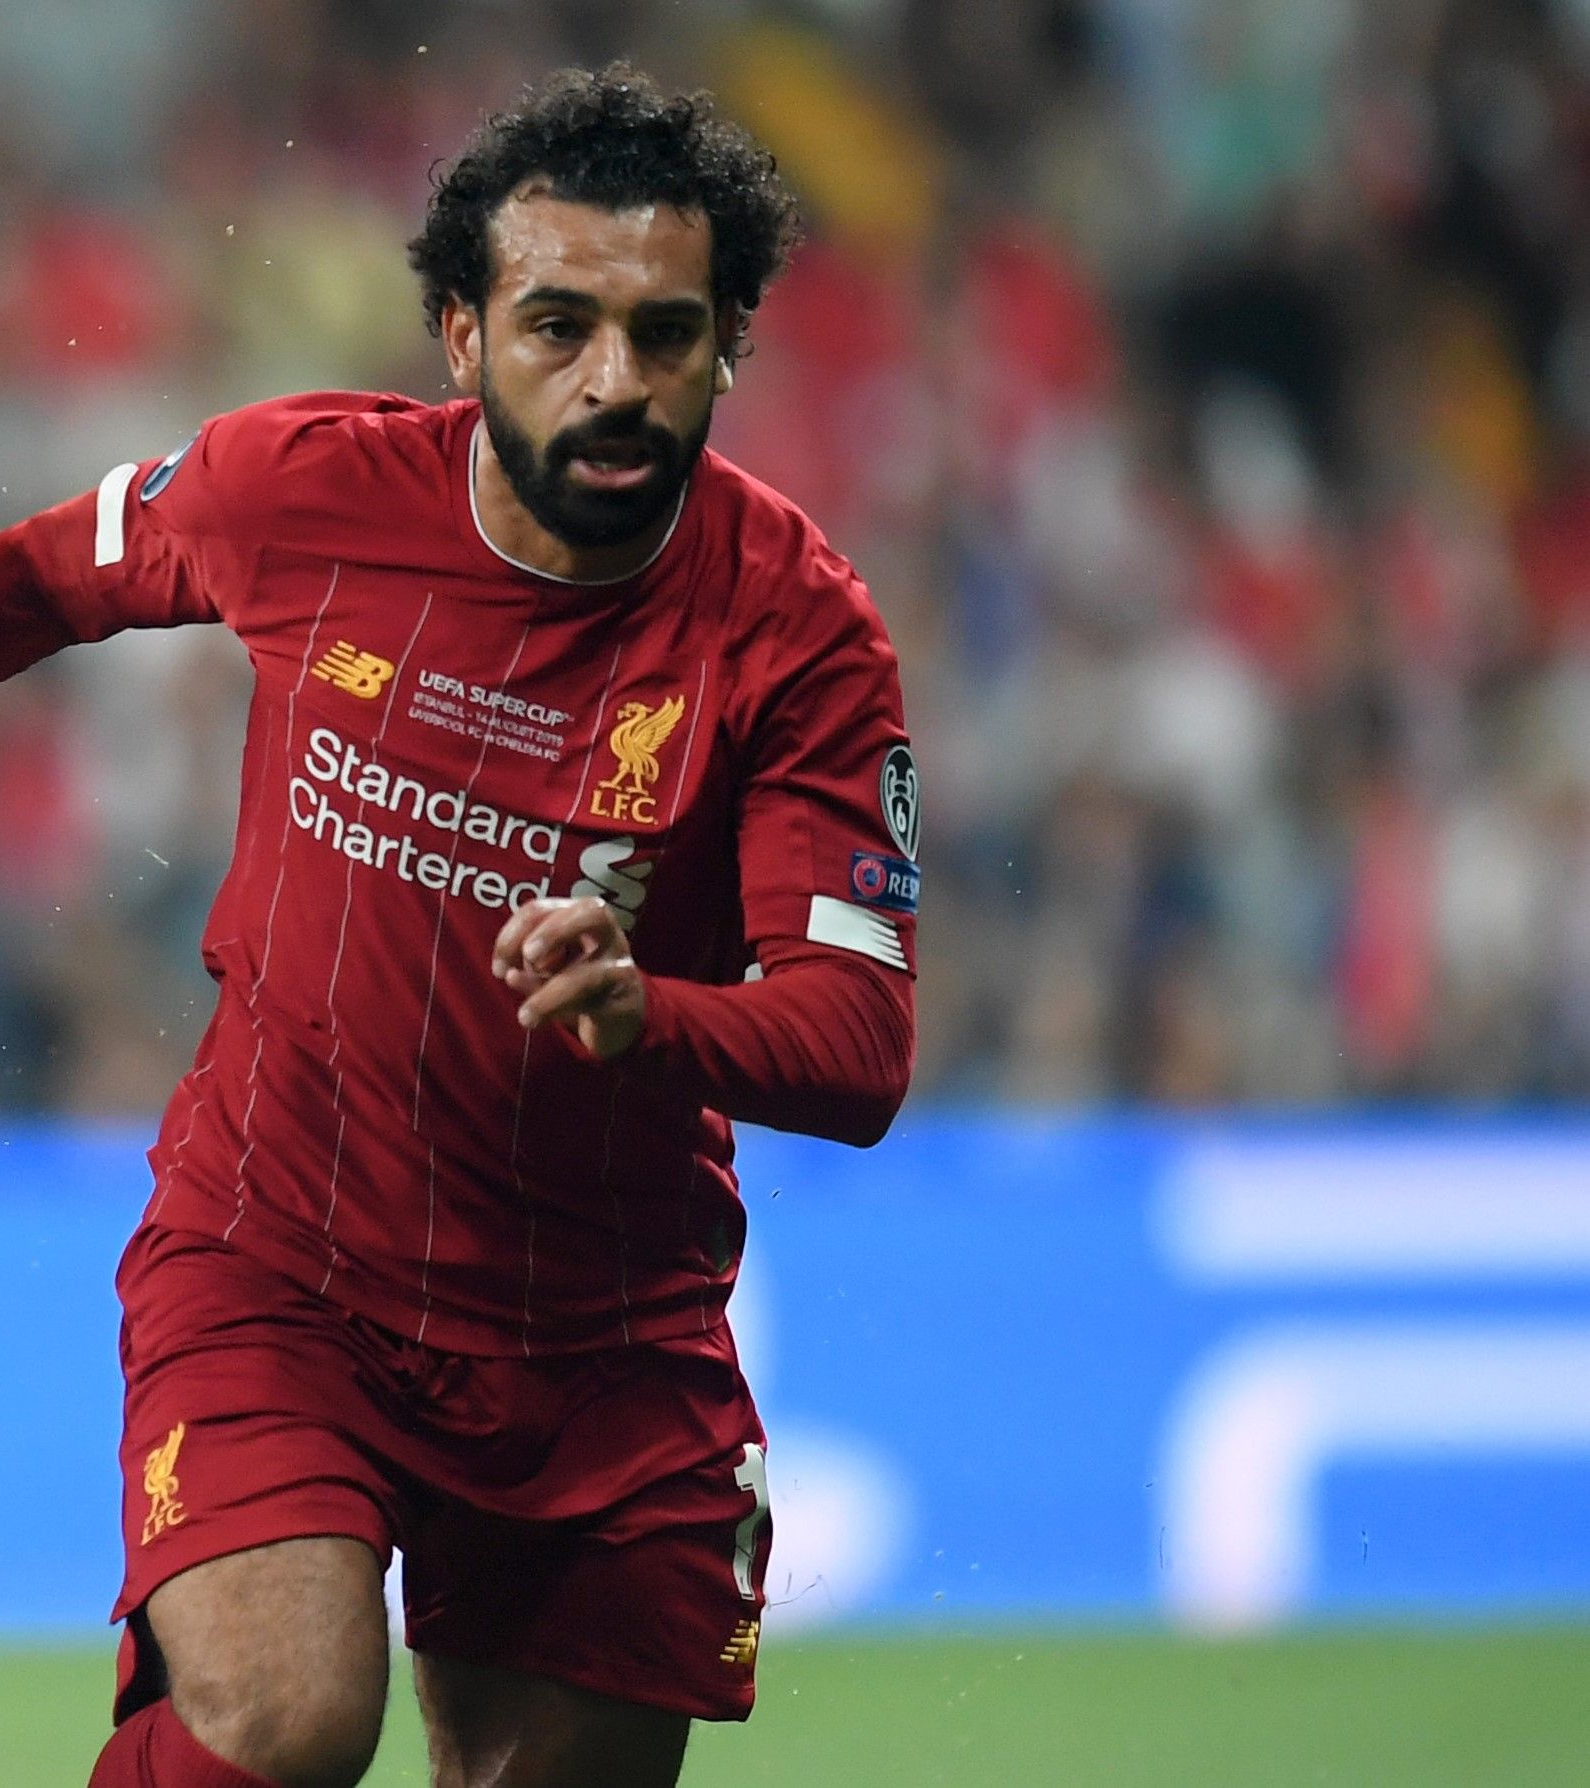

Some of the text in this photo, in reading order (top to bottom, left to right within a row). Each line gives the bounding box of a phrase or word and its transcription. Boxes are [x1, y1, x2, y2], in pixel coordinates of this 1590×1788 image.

[419, 669, 466, 699] UEFA
[468, 685, 527, 718] SUPER
[544, 748, 561, 762] FC
[304, 728, 562, 864] Standard
[895, 802, 907, 833] 6
[289, 776, 551, 915] Chartered
